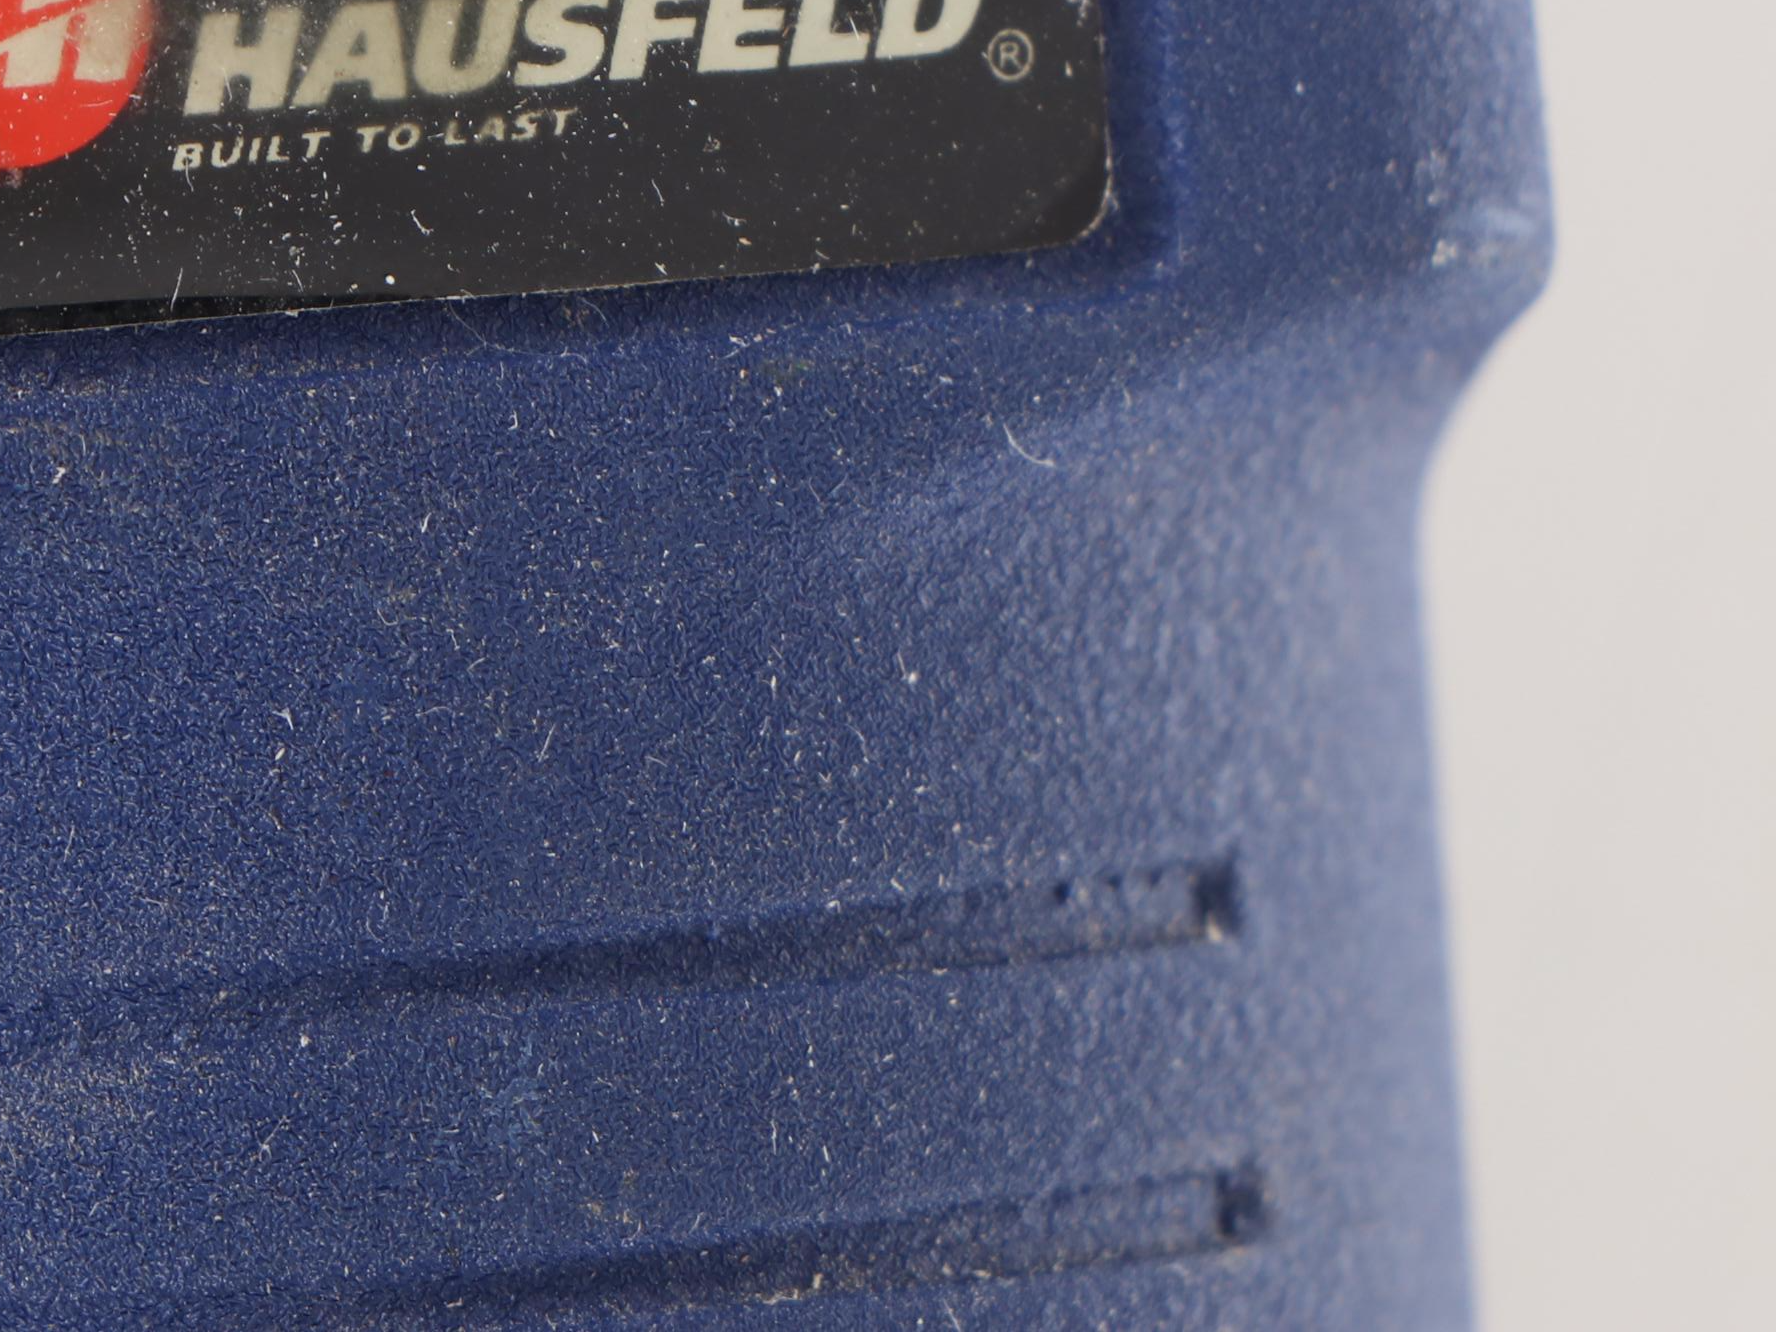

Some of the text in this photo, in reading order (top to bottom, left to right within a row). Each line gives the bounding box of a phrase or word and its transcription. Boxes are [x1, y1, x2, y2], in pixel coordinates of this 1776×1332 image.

[173, 108, 579, 171] BUILT TO LAST
